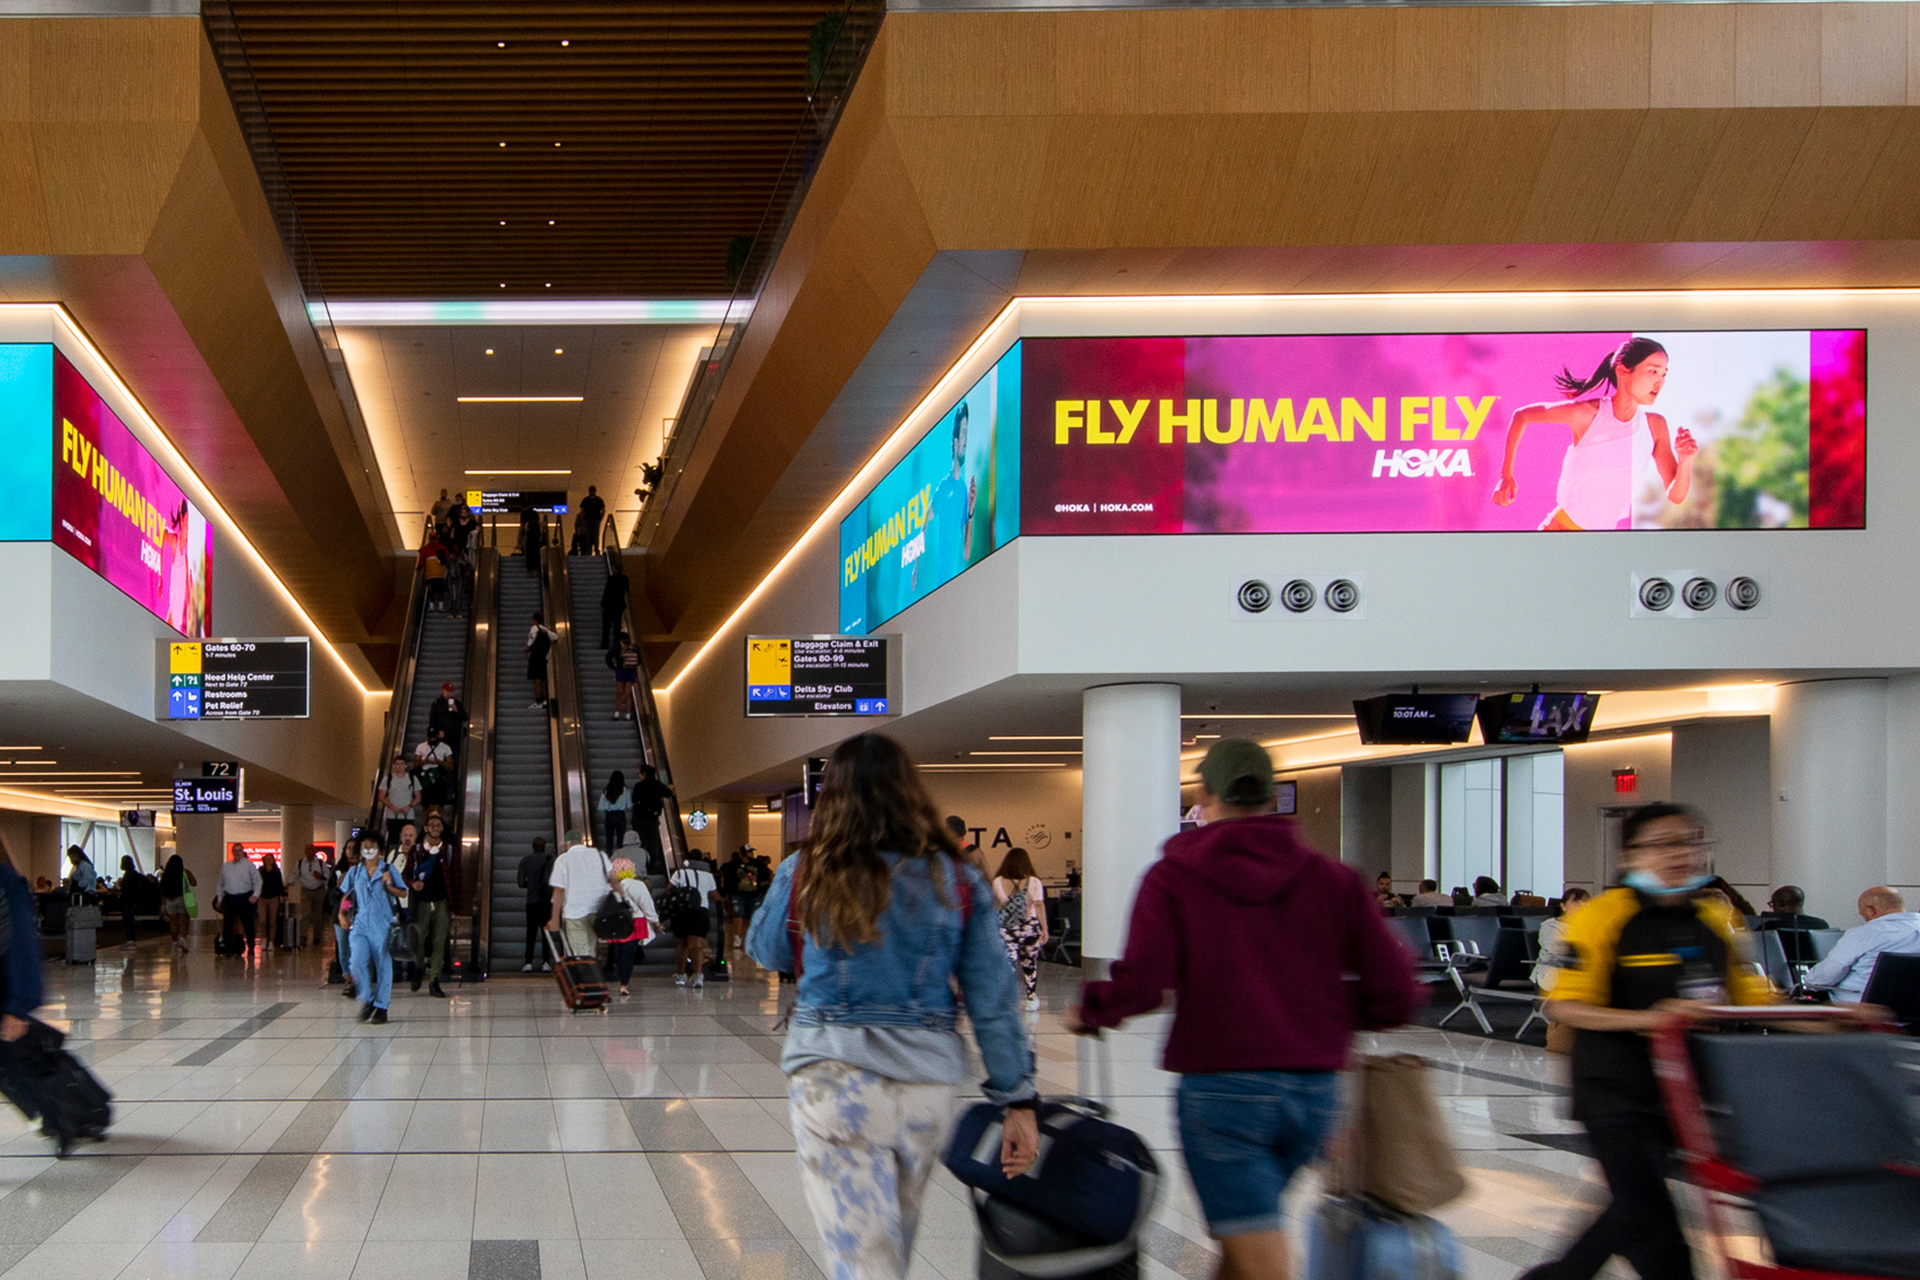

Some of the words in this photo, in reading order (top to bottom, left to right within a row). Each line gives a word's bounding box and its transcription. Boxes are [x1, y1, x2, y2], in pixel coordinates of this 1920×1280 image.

[1055, 399, 1150, 444] FLY
[1159, 397, 1385, 444] HUMAN
[1400, 396, 1496, 441] FLY
[1372, 448, 1473, 478] HOKA
[63, 417, 91, 479] FLY
[92, 447, 146, 533] HUMAN
[147, 502, 166, 547] FLY
[1054, 504, 1090, 512] @HOKA
[1100, 503, 1154, 512] HOKA.COM
[845, 546, 862, 587] FLY
[862, 506, 906, 572] HUMAN
[906, 483, 932, 535] FLY
[140, 539, 162, 577] HOKA
[901, 530, 925, 569] HOKA
[794, 641, 829, 650] Baggage
[227, 673, 246, 683] Help
[817, 685, 833, 694] Sky
[210, 763, 229, 776] 72
[175, 788, 194, 801] St.
[196, 788, 233, 801] Louis
